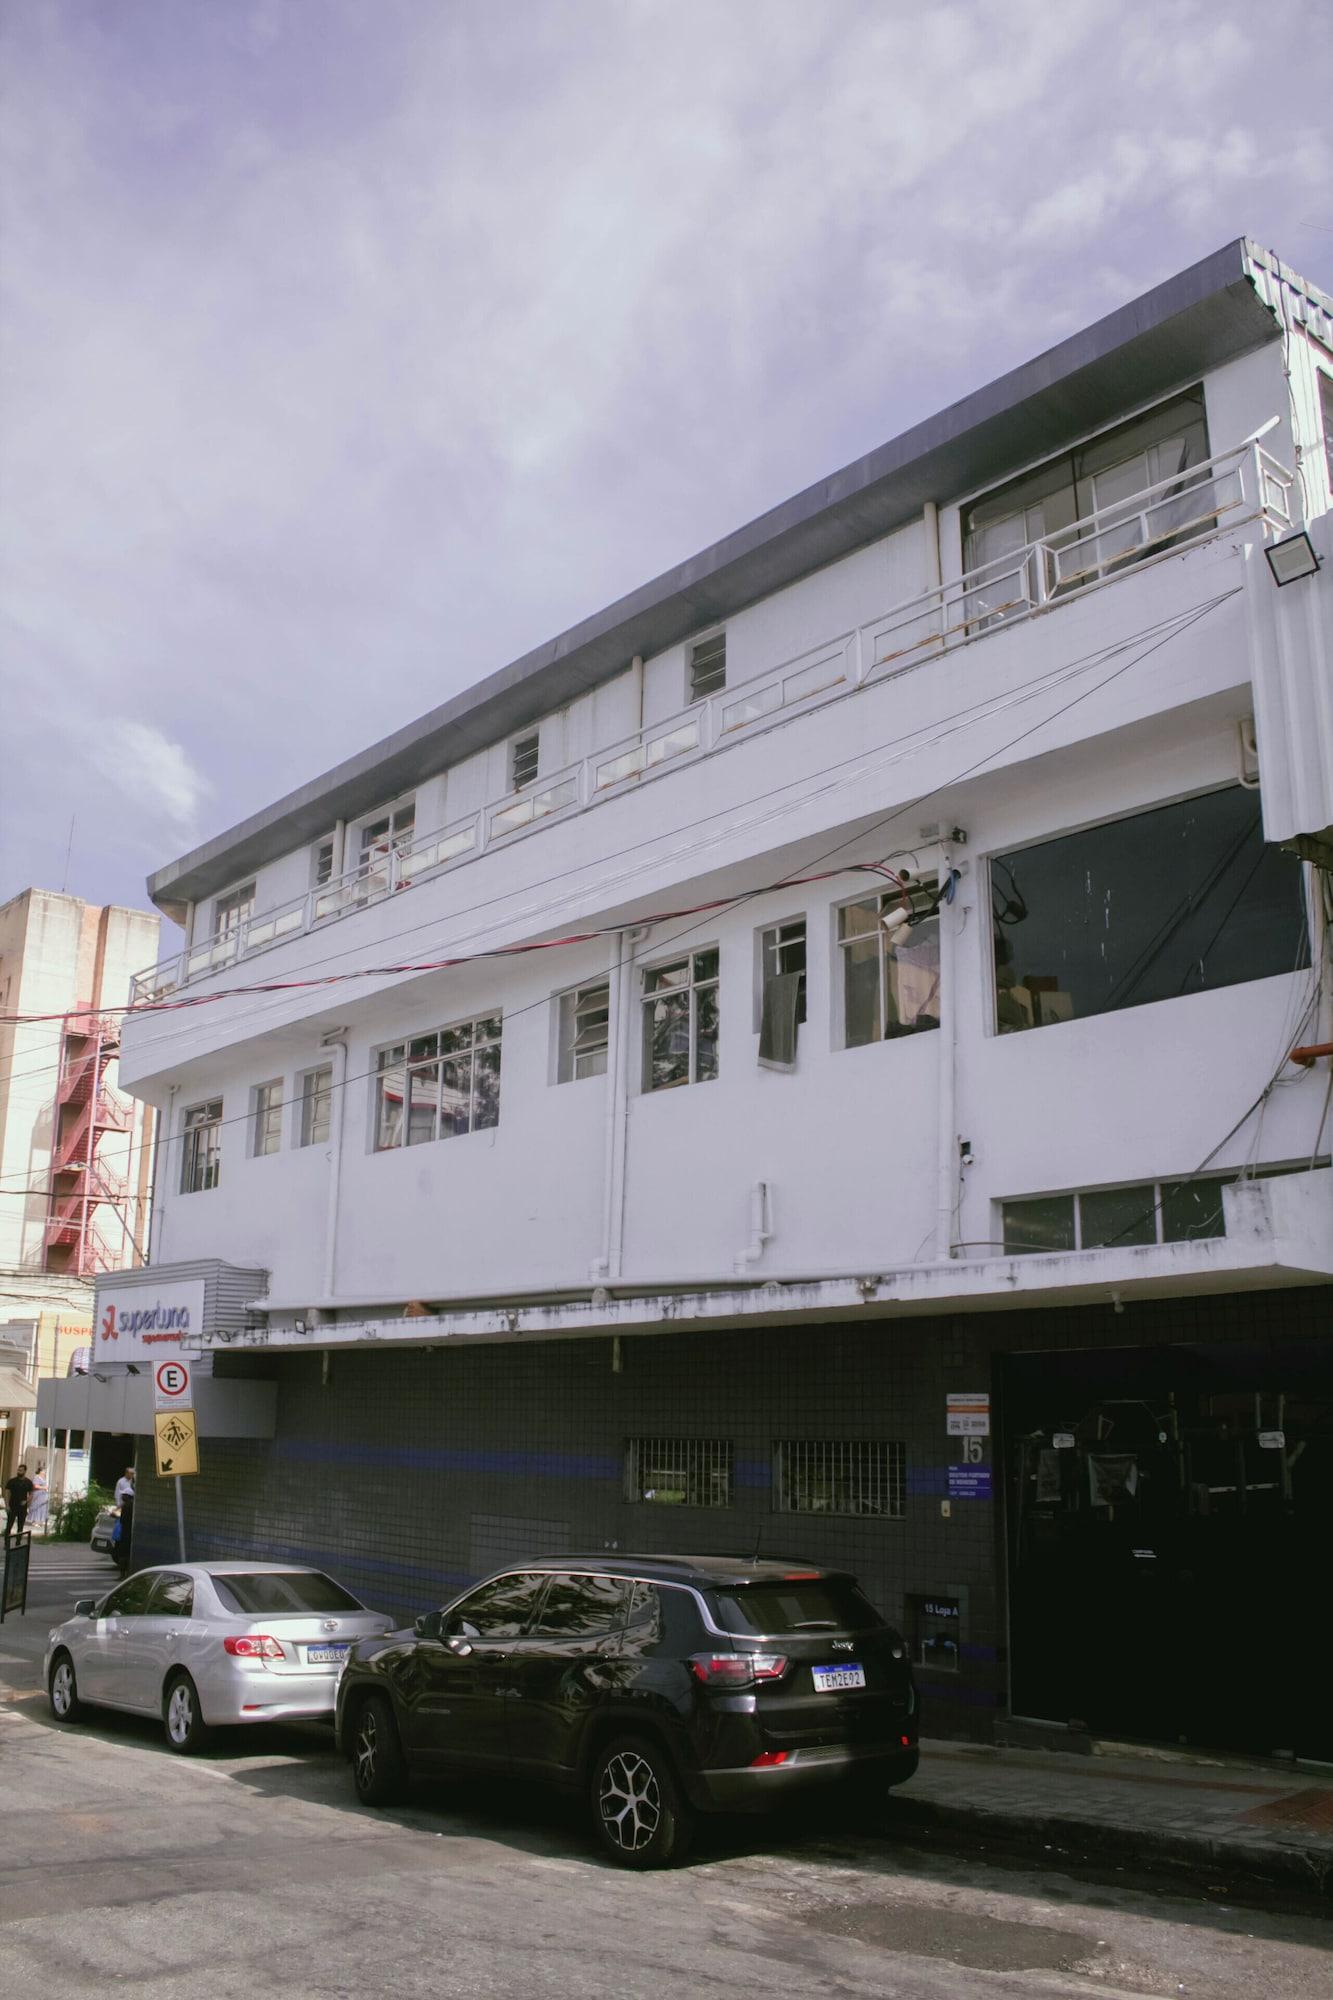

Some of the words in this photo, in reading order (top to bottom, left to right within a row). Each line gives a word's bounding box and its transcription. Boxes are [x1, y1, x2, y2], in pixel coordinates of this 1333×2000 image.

[166, 1370, 178, 1387] E
[962, 1436, 984, 1464] 15
[832, 1640, 854, 1651] Jeep
